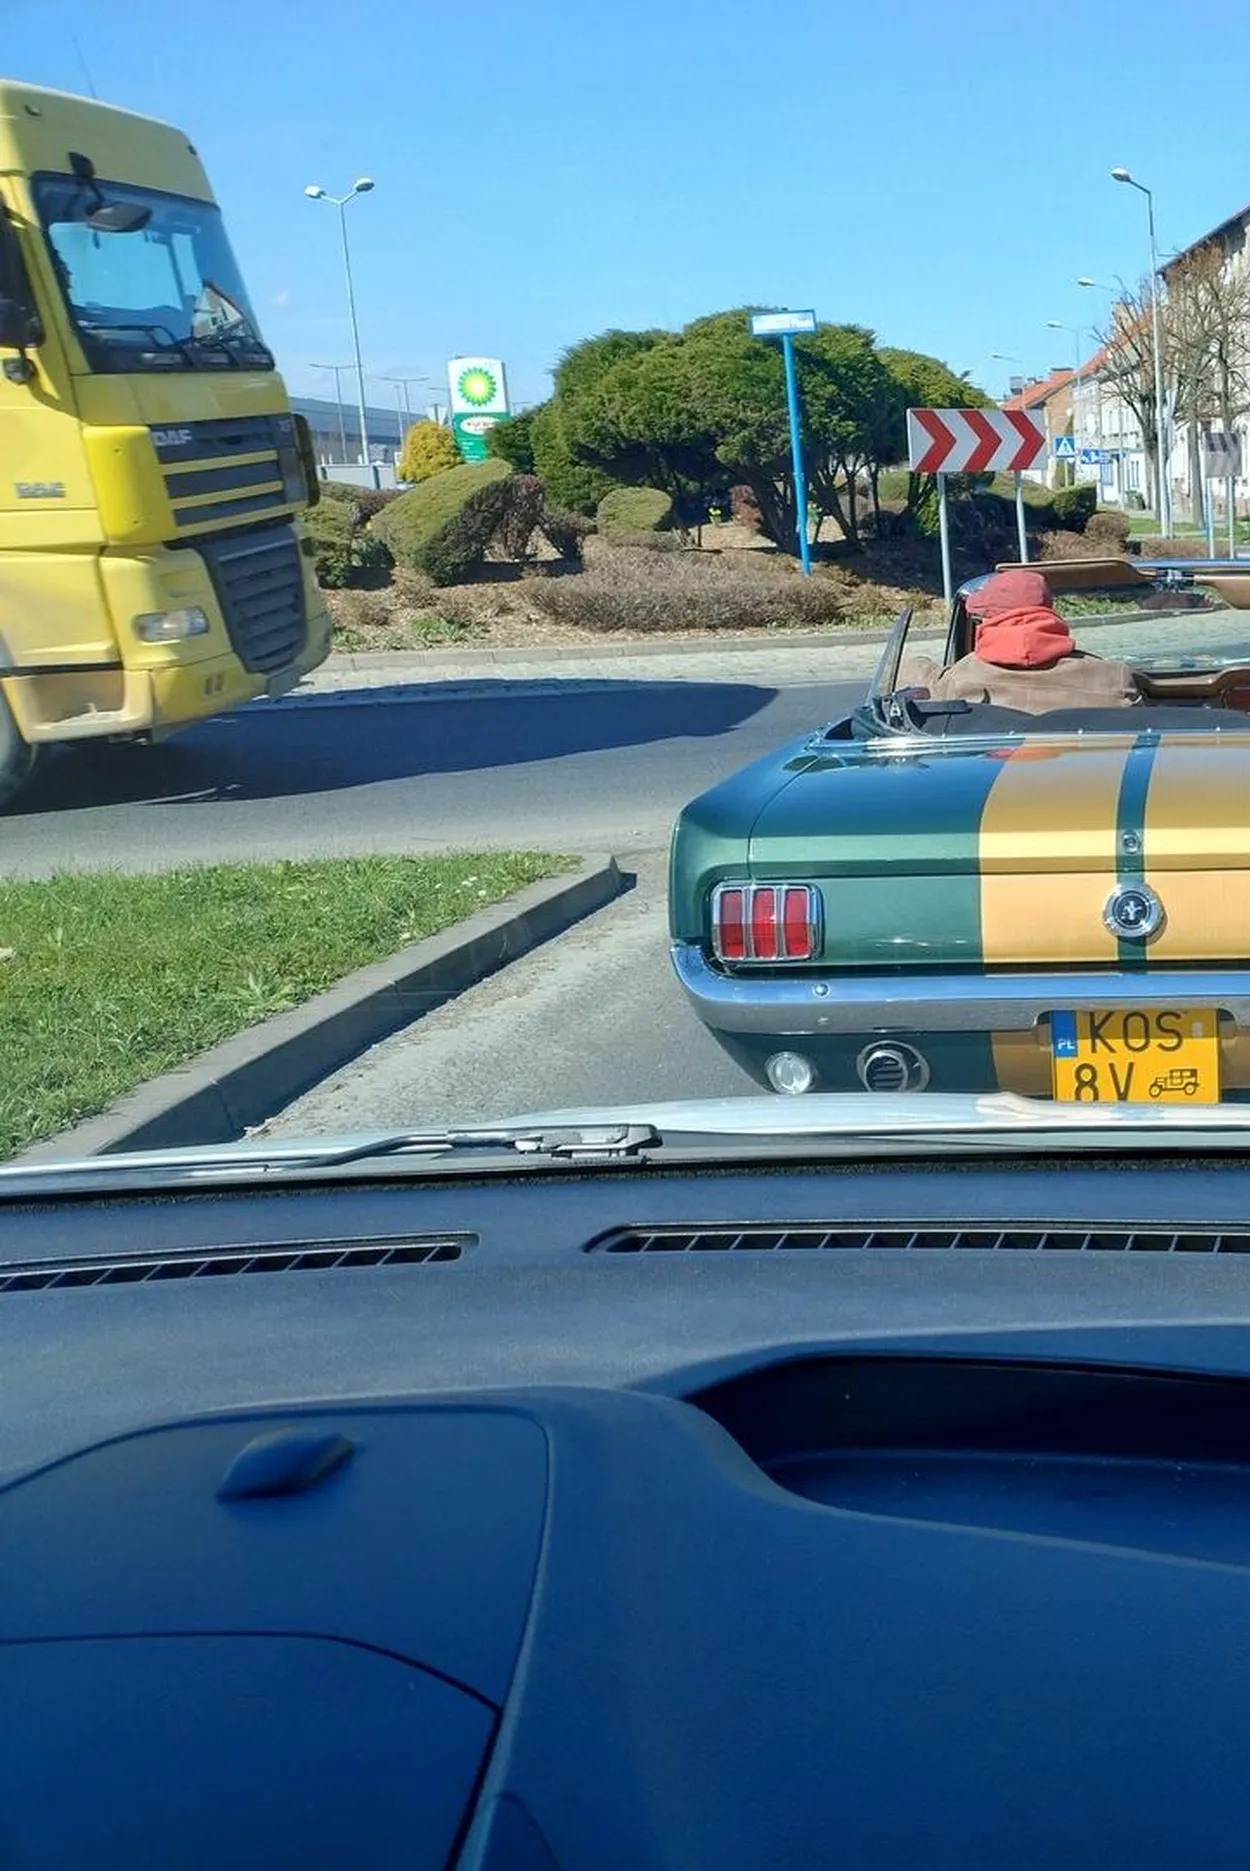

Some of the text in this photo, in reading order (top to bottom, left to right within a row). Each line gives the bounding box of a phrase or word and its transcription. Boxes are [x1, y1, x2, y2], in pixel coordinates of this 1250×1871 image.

[1057, 1039, 1075, 1050] PL
[1089, 1010, 1183, 1054] KOS
[1074, 1061, 1135, 1101] 8V
